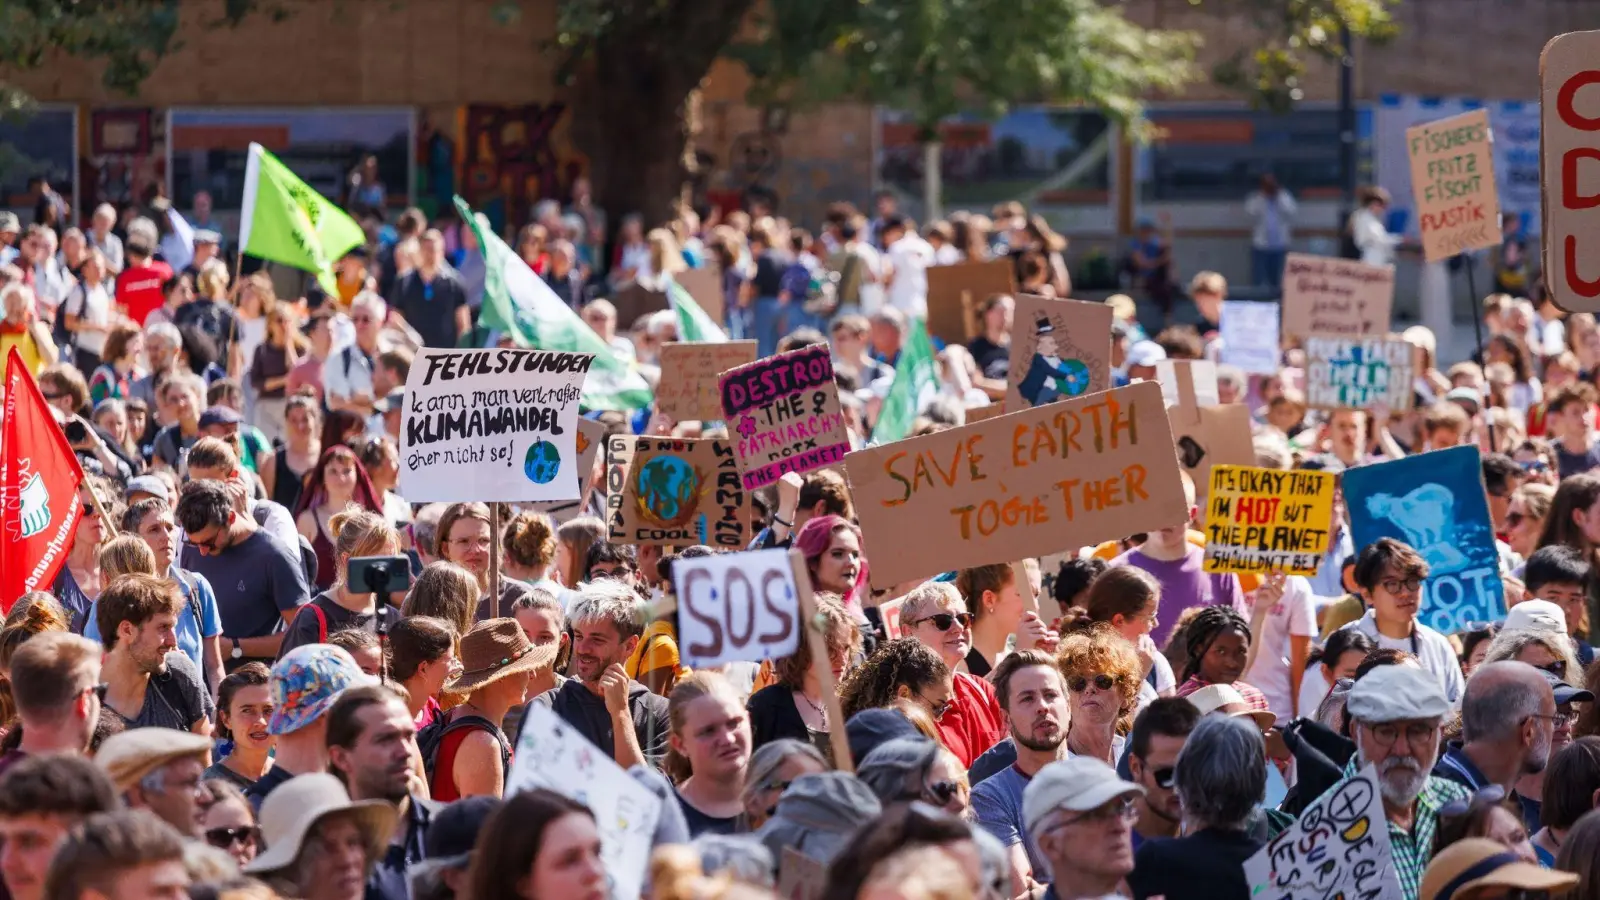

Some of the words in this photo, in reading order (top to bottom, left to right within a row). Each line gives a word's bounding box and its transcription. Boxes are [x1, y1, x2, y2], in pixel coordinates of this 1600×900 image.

[1428, 153, 1476, 178] FRITZ
[422, 350, 597, 386] FEHLSTUNDEN
[727, 355, 831, 409] DESTROY
[412, 390, 467, 413] kann
[471, 388, 509, 408] man
[759, 392, 805, 425] THE
[407, 406, 564, 447] KLIMAWANDEL
[738, 413, 841, 459] PATRIARCHY
[407, 450, 441, 471] eher
[444, 444, 486, 465] nicht
[881, 433, 987, 507] SAVE
[1011, 393, 1138, 467] EARTH
[608, 438, 627, 538] GLOBAL
[712, 440, 743, 546] WARMING
[744, 466, 775, 487] THE
[1240, 470, 1286, 495] OKAY
[1289, 472, 1324, 496] THAT
[1234, 496, 1281, 525] HOT
[1283, 501, 1313, 523] BUT
[1209, 523, 1241, 547] THE
[1244, 526, 1328, 551] PLANET
[684, 566, 793, 658] SOS
